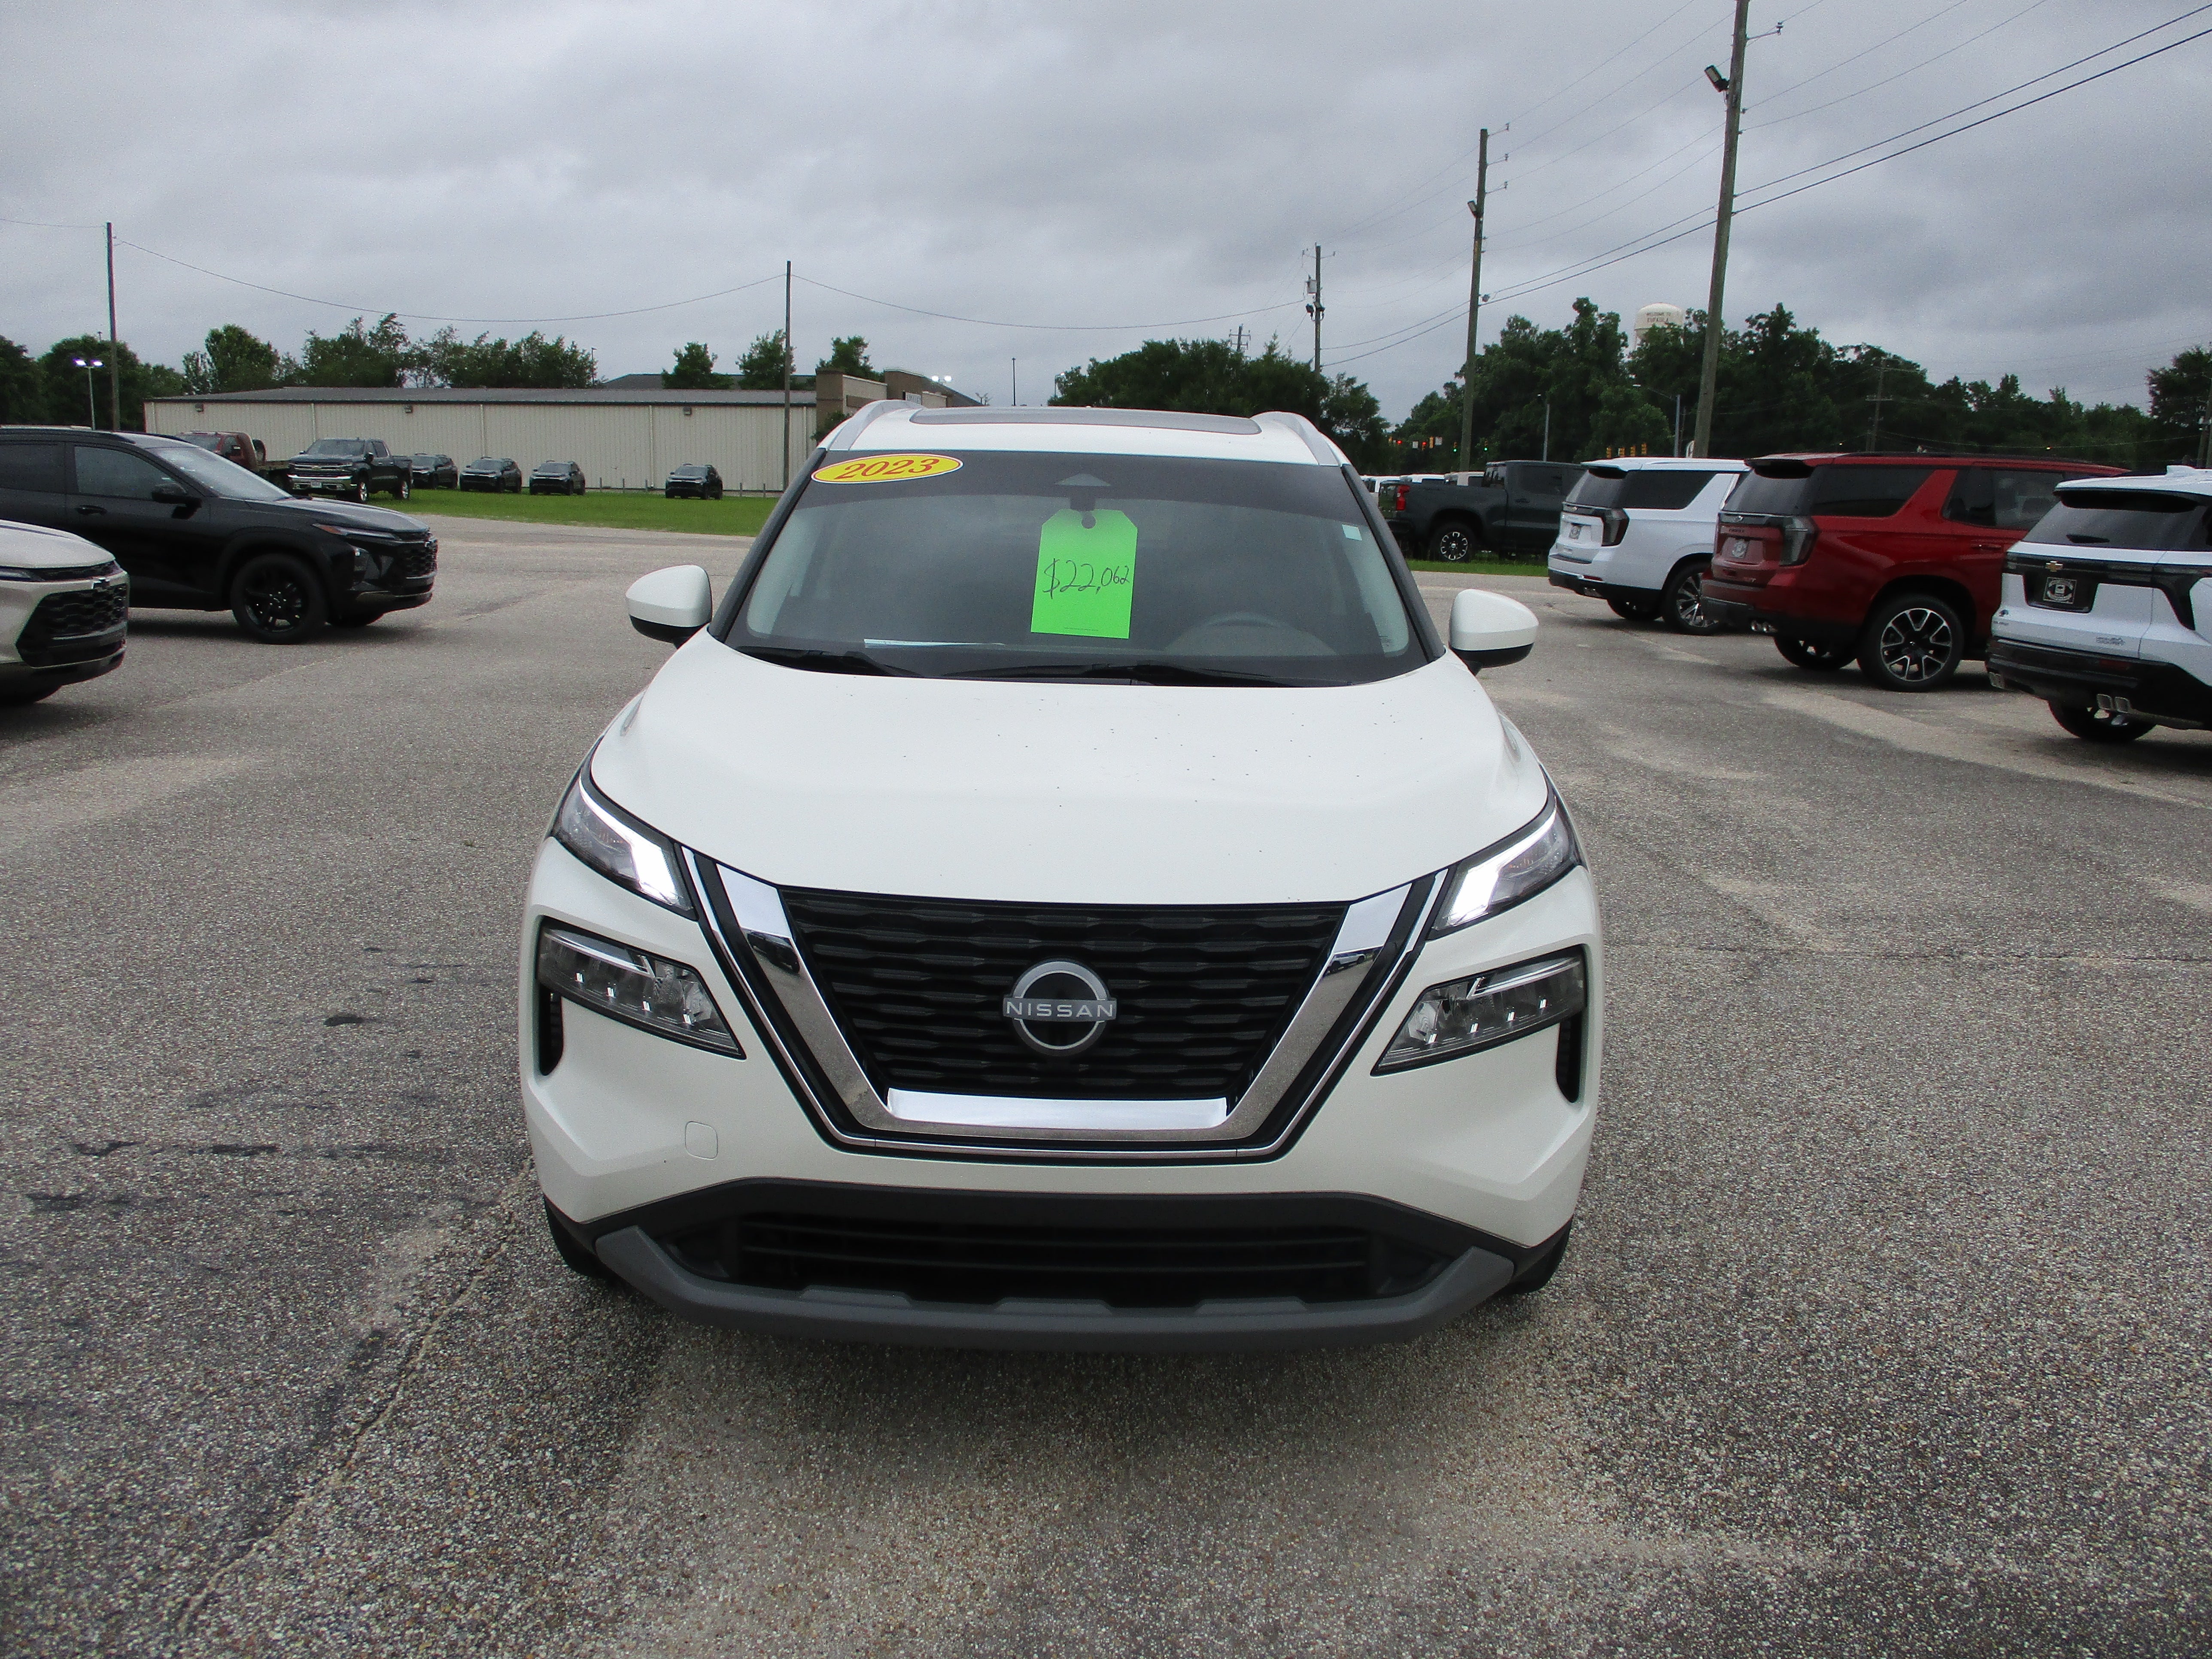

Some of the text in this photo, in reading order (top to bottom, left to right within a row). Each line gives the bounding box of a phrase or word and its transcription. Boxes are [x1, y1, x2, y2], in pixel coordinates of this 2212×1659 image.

[834, 459, 940, 480] 2023
[1042, 558, 1130, 599] $22,062
[1006, 1002, 1113, 1017] NISSAN
